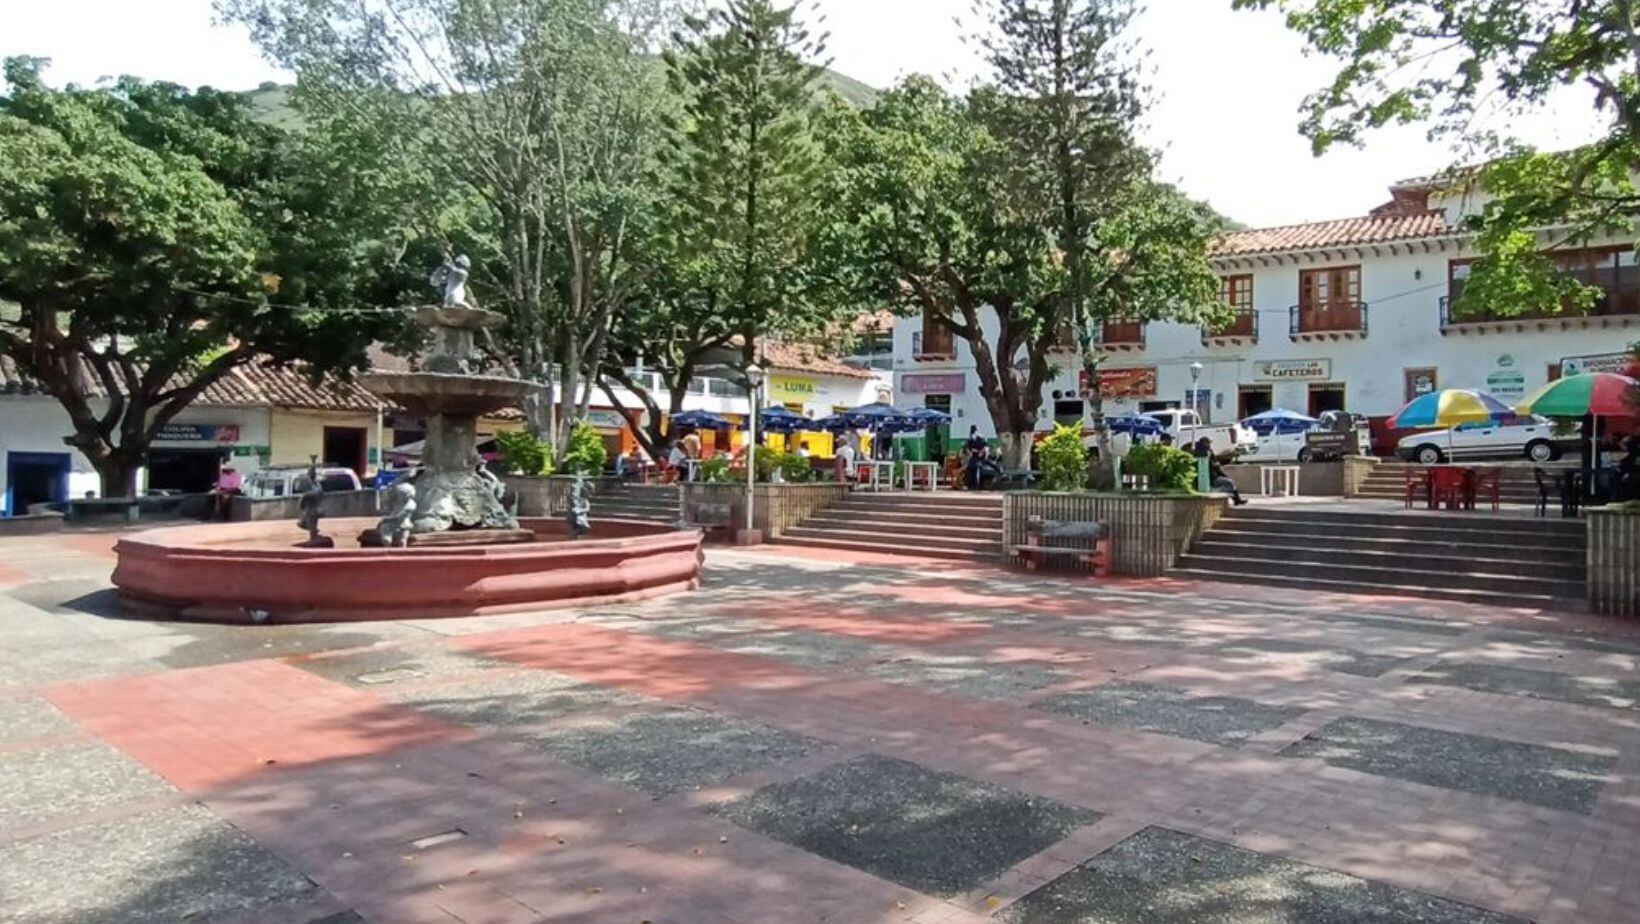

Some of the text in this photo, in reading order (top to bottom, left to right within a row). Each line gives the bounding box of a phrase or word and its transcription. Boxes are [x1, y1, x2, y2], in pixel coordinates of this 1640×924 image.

[1583, 357, 1626, 367] INFORMACIÓ
[1272, 368, 1323, 377] CAFETEROS
[784, 382, 813, 393] LUMA
